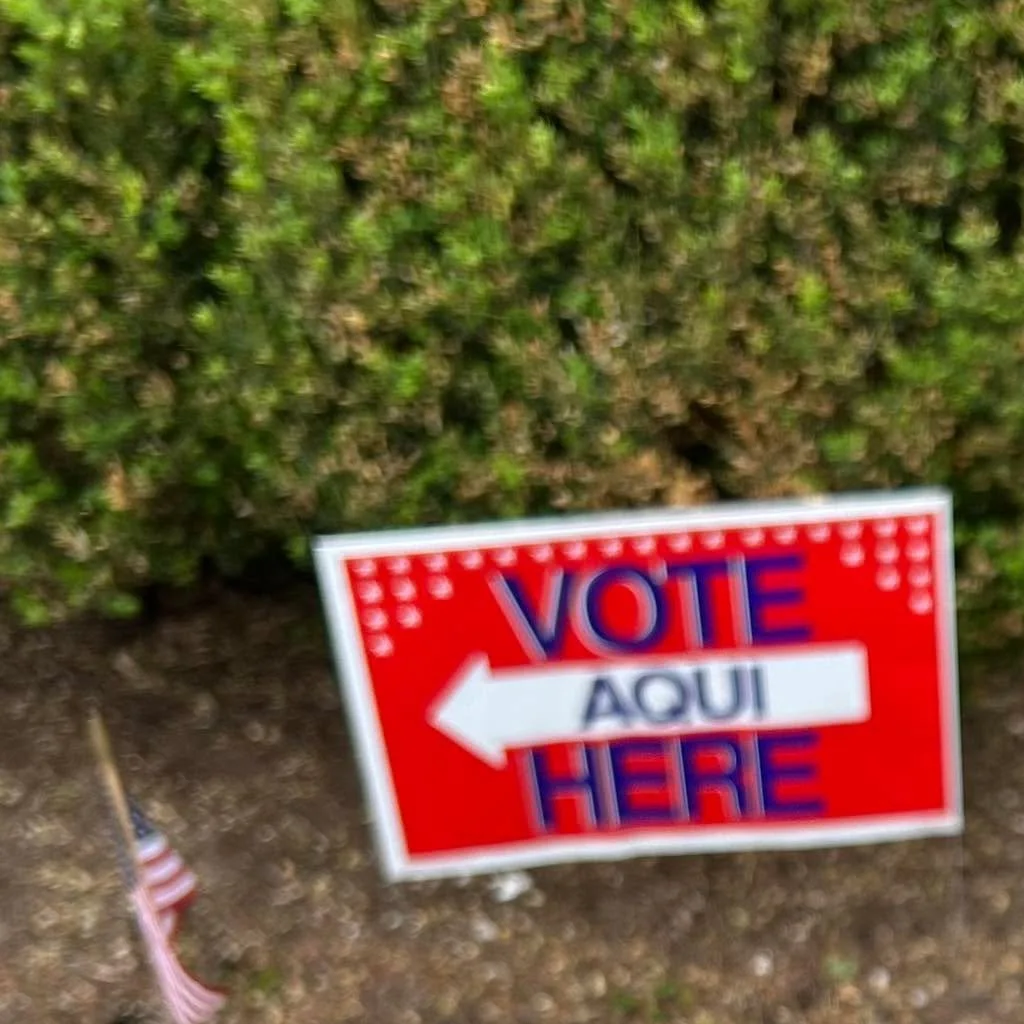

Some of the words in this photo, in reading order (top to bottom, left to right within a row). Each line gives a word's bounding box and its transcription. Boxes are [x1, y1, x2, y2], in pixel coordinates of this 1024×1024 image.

[488, 553, 813, 660] VOTE
[579, 664, 769, 730] AQUI
[527, 729, 825, 834] HERE
